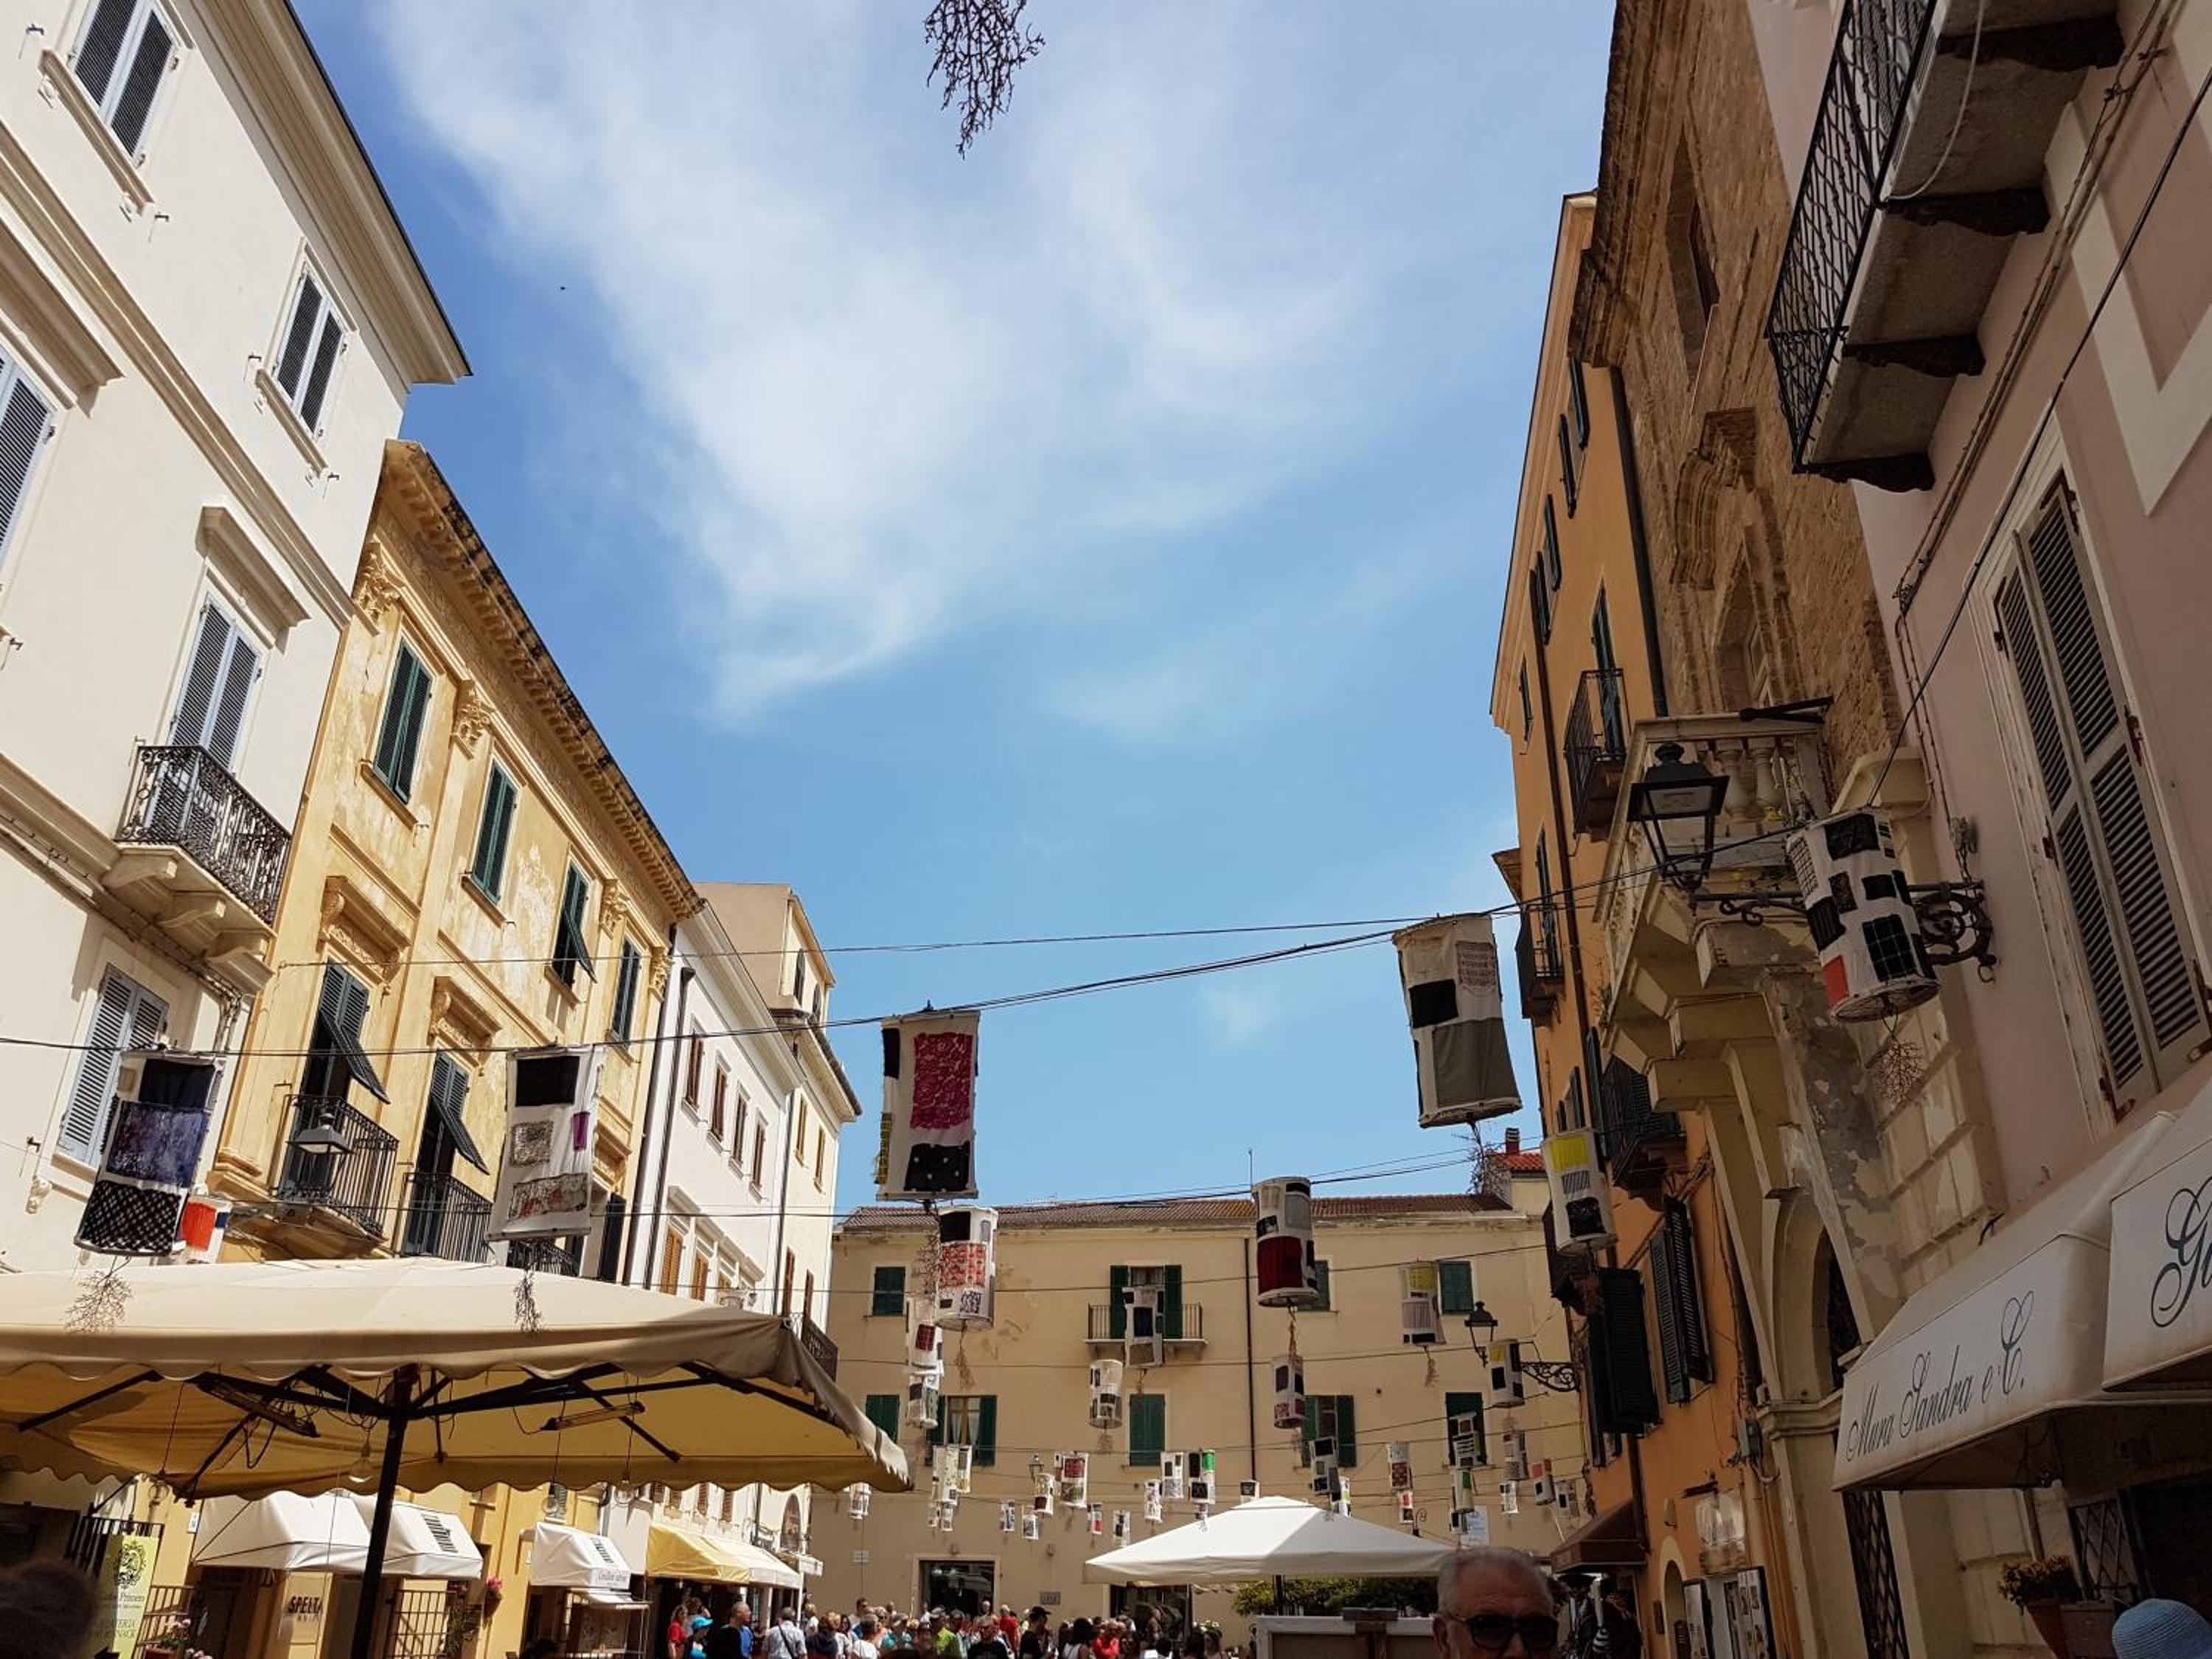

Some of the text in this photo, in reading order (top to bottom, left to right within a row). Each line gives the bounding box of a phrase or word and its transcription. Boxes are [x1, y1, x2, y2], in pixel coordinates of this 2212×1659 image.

[1846, 1382, 1895, 1462] Mura
[1899, 1344, 1975, 1439] Sandra
[1981, 1365, 1994, 1404] e
